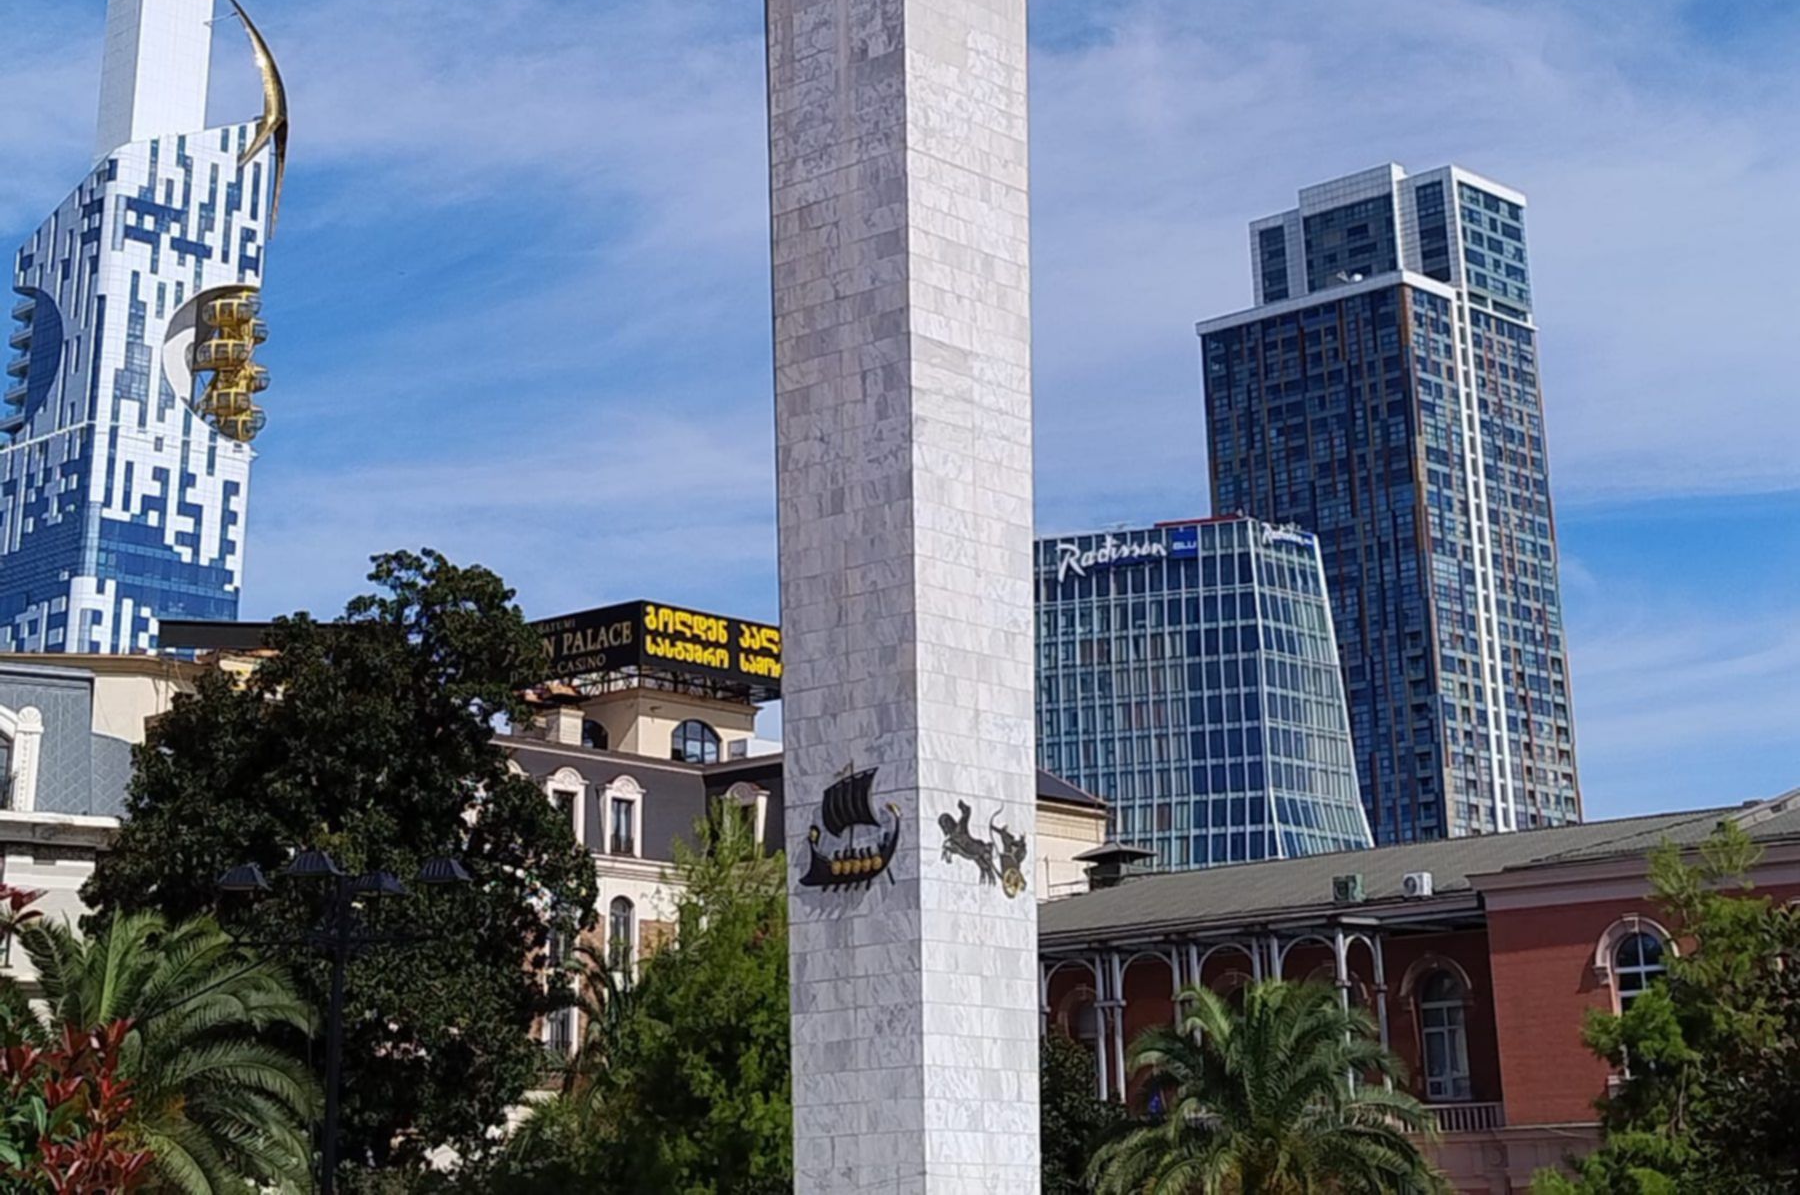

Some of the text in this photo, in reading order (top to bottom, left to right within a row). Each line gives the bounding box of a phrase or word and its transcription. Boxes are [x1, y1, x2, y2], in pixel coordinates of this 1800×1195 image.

[1055, 533, 1197, 583] Radisson BLU
[562, 621, 633, 655] PALACE
[644, 605, 729, 644] გოლდენ
[557, 652, 607, 674] CASINO
